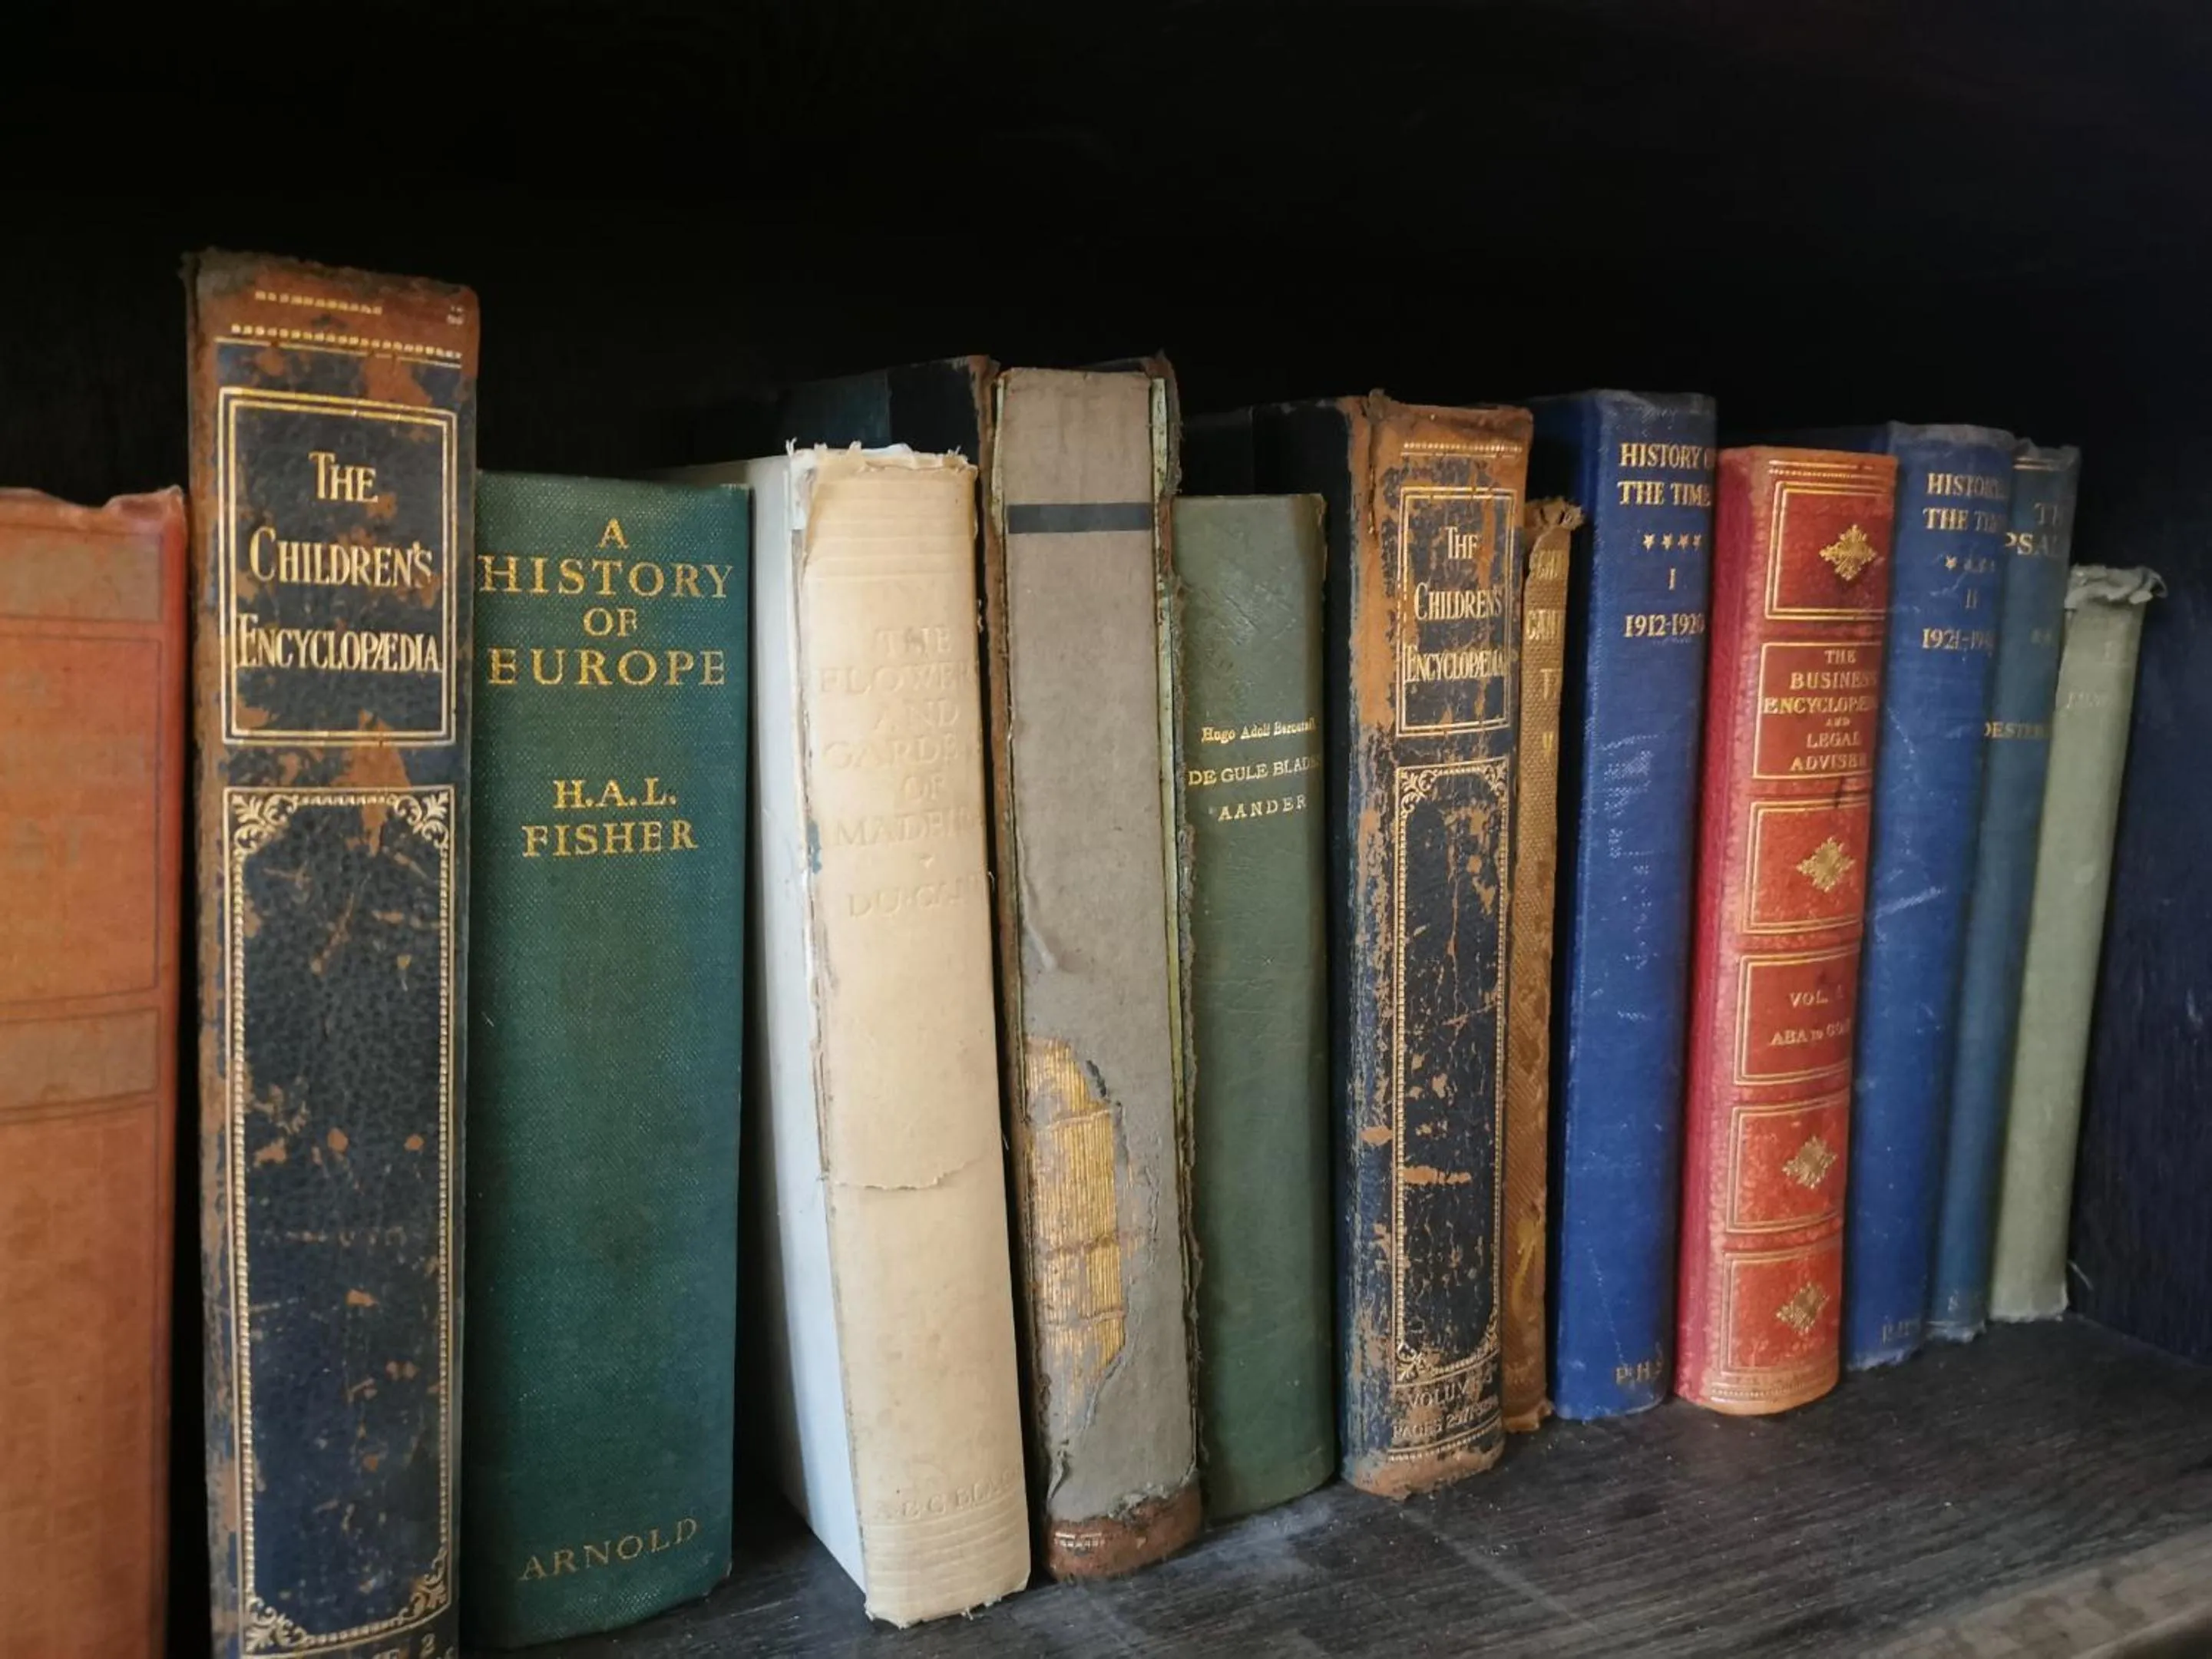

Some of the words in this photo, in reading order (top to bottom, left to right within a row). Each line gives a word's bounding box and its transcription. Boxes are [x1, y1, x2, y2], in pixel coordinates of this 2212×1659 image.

[1618, 442, 1703, 469] HISTORY
[309, 451, 379, 503] THE
[1617, 481, 1665, 506] THE
[1670, 482, 1711, 507] TIME
[599, 518, 629, 548] A
[1922, 507, 1969, 530] THE
[249, 527, 433, 587] CHILDREN'S
[478, 554, 732, 597] HISTORY
[583, 607, 637, 637] OF
[875, 625, 952, 659] THE
[1824, 649, 1857, 664] THE
[488, 648, 726, 686] EUROPE
[1201, 726, 1235, 744] Hugo
[1806, 731, 1862, 749] LEGAL
[1188, 770, 1217, 786] DE
[1221, 763, 1268, 783] GULE
[1218, 793, 1307, 821] AANDER
[522, 819, 698, 857] FISHER
[518, 1518, 697, 1581] ARNOLD
